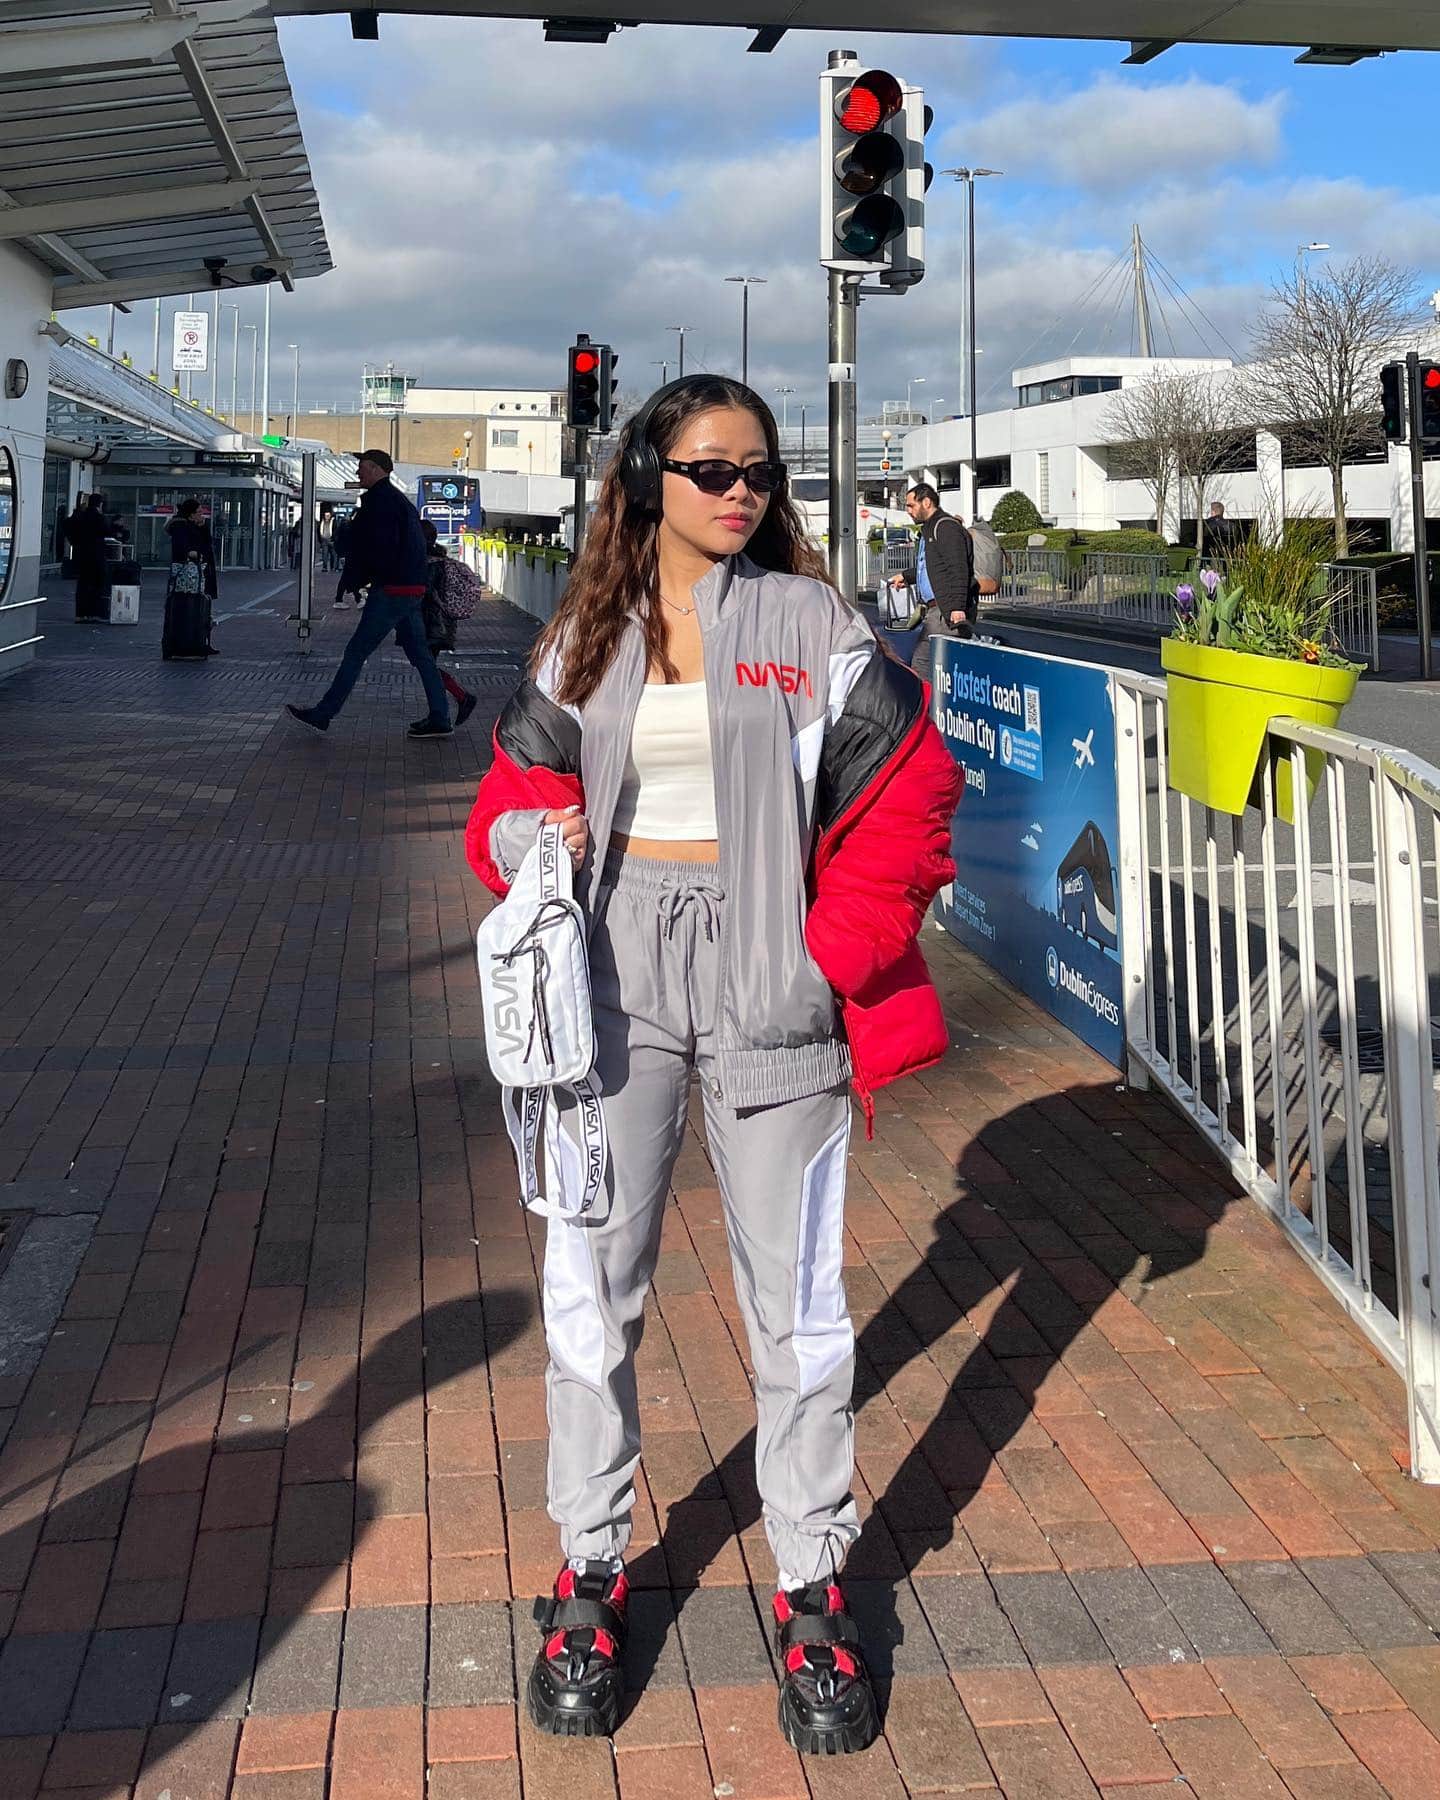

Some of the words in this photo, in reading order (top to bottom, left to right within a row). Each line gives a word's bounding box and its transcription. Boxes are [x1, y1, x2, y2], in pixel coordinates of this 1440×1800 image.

[736, 662, 813, 699] NASA
[935, 664, 952, 695] The
[953, 662, 991, 706] fastest
[992, 683, 1022, 717] coach
[936, 707, 946, 734] to
[947, 708, 975, 746] Dublin
[976, 718, 996, 760] City
[543, 832, 556, 876] NASA
[490, 957, 525, 1058] NASA
[1059, 960, 1120, 1026] DublinExpress
[526, 1086, 540, 1128] NASA
[582, 1094, 599, 1136] NASA
[587, 1144, 601, 1189] NASA
